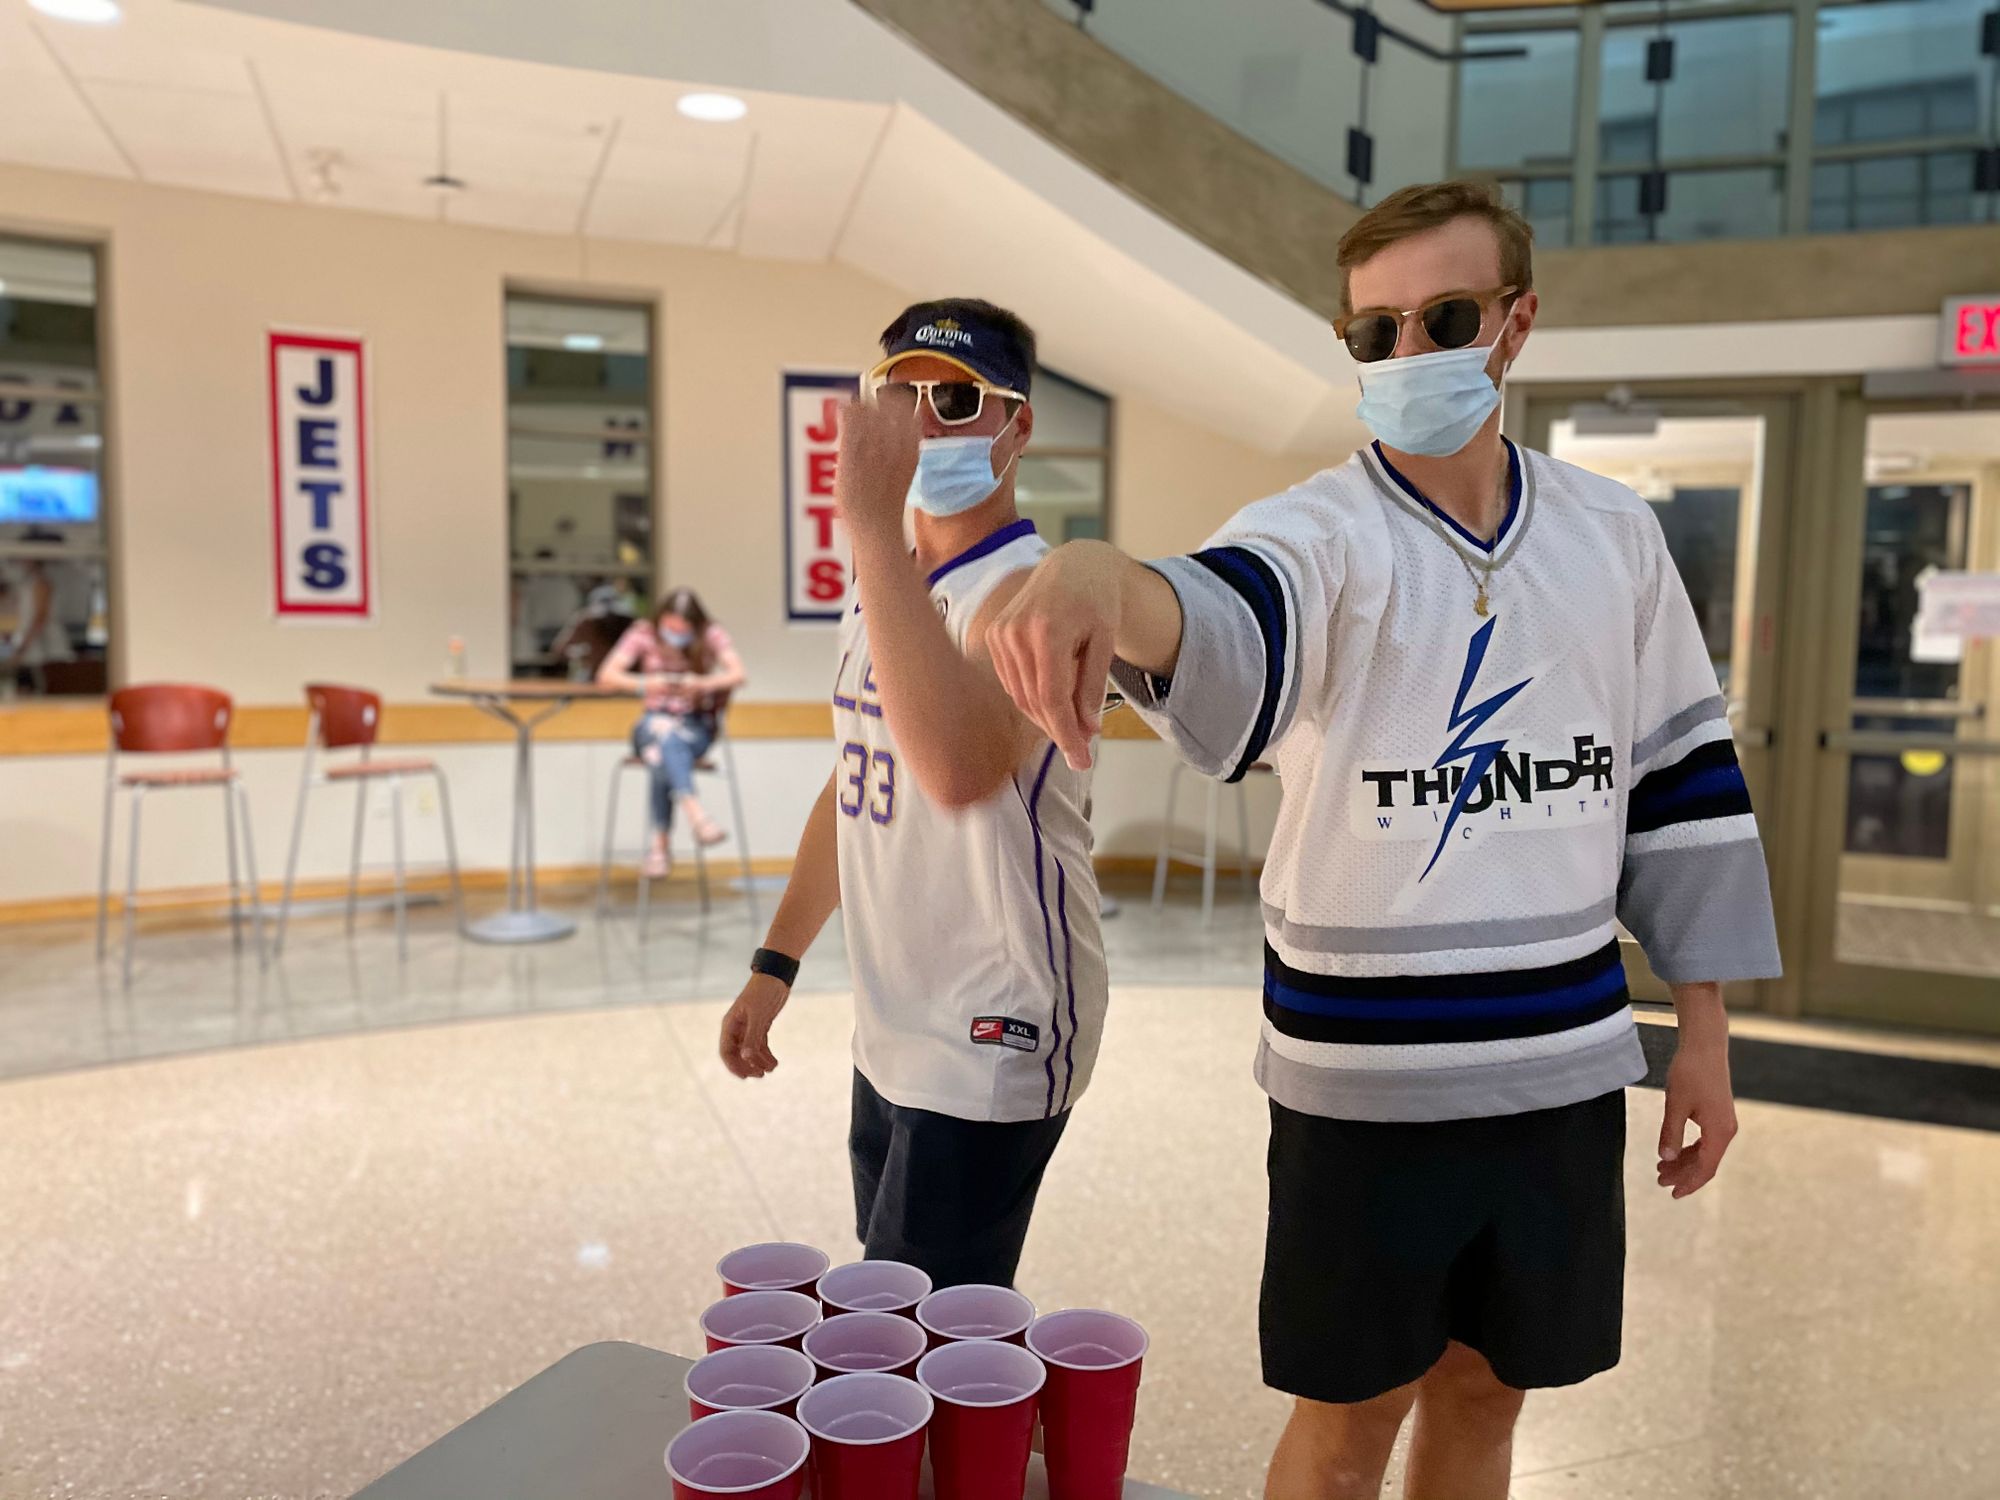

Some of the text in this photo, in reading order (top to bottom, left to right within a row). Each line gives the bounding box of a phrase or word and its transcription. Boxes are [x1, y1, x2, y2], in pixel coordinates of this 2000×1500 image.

[915, 324, 973, 346] Corona
[297, 357, 348, 591] JETS
[805, 398, 845, 604] JETS
[840, 741, 895, 826] 33
[1362, 733, 1614, 814] THUNDER
[1008, 1023, 1031, 1037] XXL
